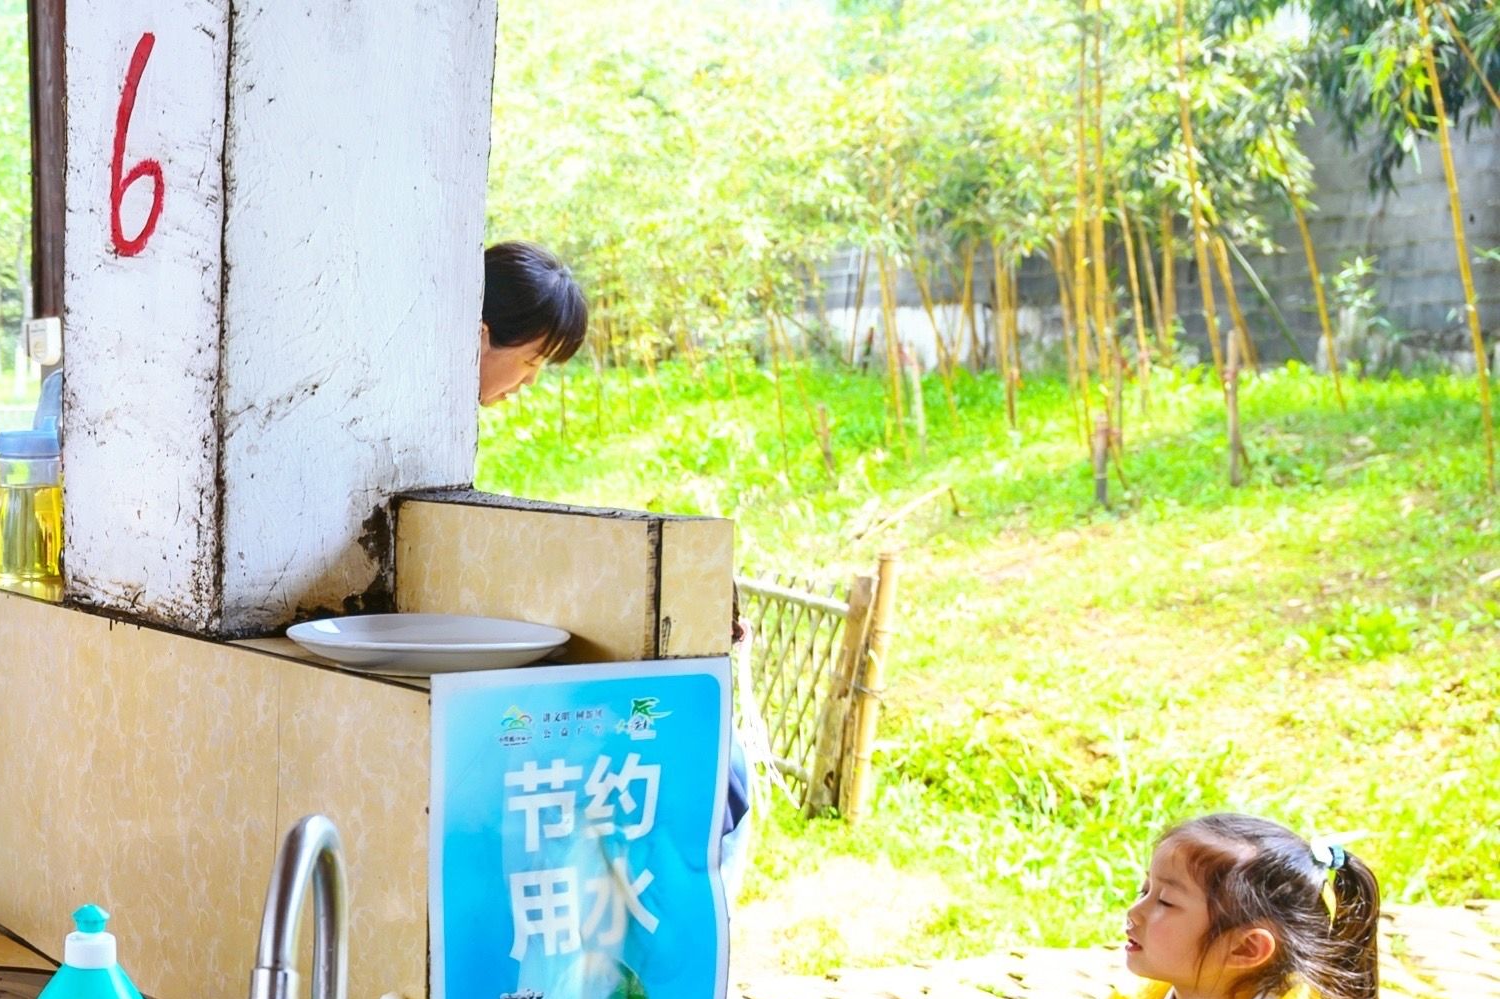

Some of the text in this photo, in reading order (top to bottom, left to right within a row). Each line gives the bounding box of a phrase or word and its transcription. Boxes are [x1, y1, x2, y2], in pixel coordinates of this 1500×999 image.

[111, 32, 164, 257] 6
[504, 752, 661, 852] 节约
[509, 857, 660, 961] 用水
